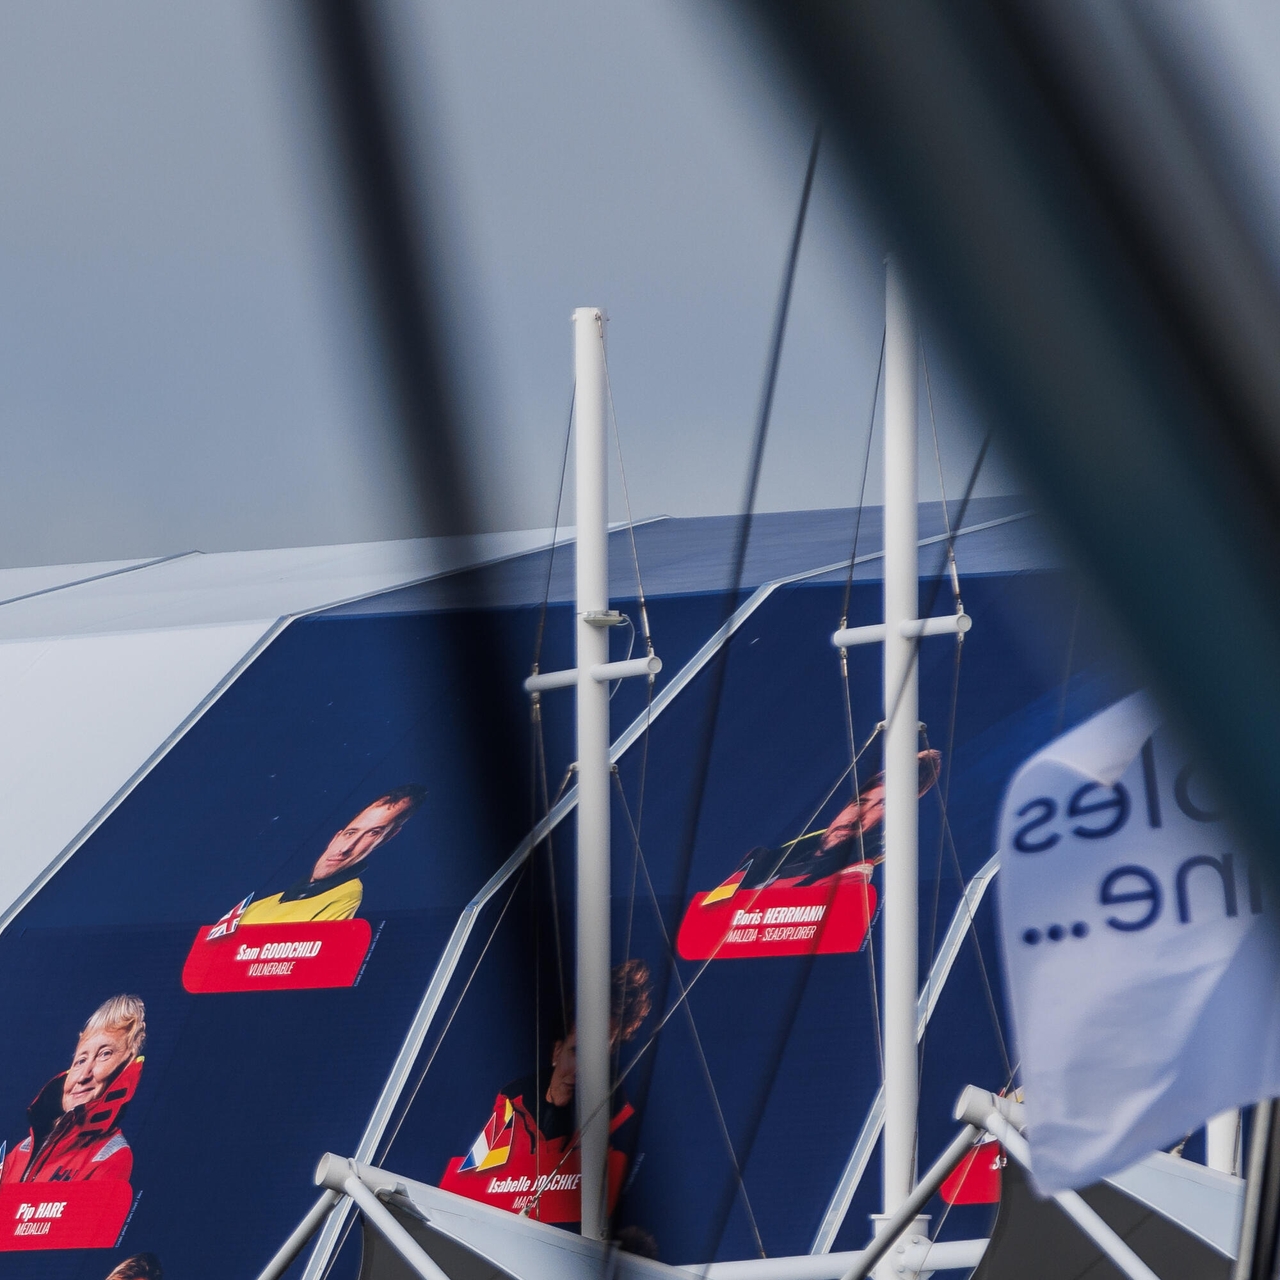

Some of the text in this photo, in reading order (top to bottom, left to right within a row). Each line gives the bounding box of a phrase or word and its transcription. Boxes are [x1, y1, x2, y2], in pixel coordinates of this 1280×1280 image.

[732, 905, 827, 925] Boris HERRMANN
[236, 941, 322, 961] Sam GOODCHILD
[248, 961, 296, 976] VULNERABLE
[487, 1176, 530, 1194] Isabelle
[15, 1202, 67, 1222] Pip HARE
[14, 1222, 51, 1236] MEDALLIA
